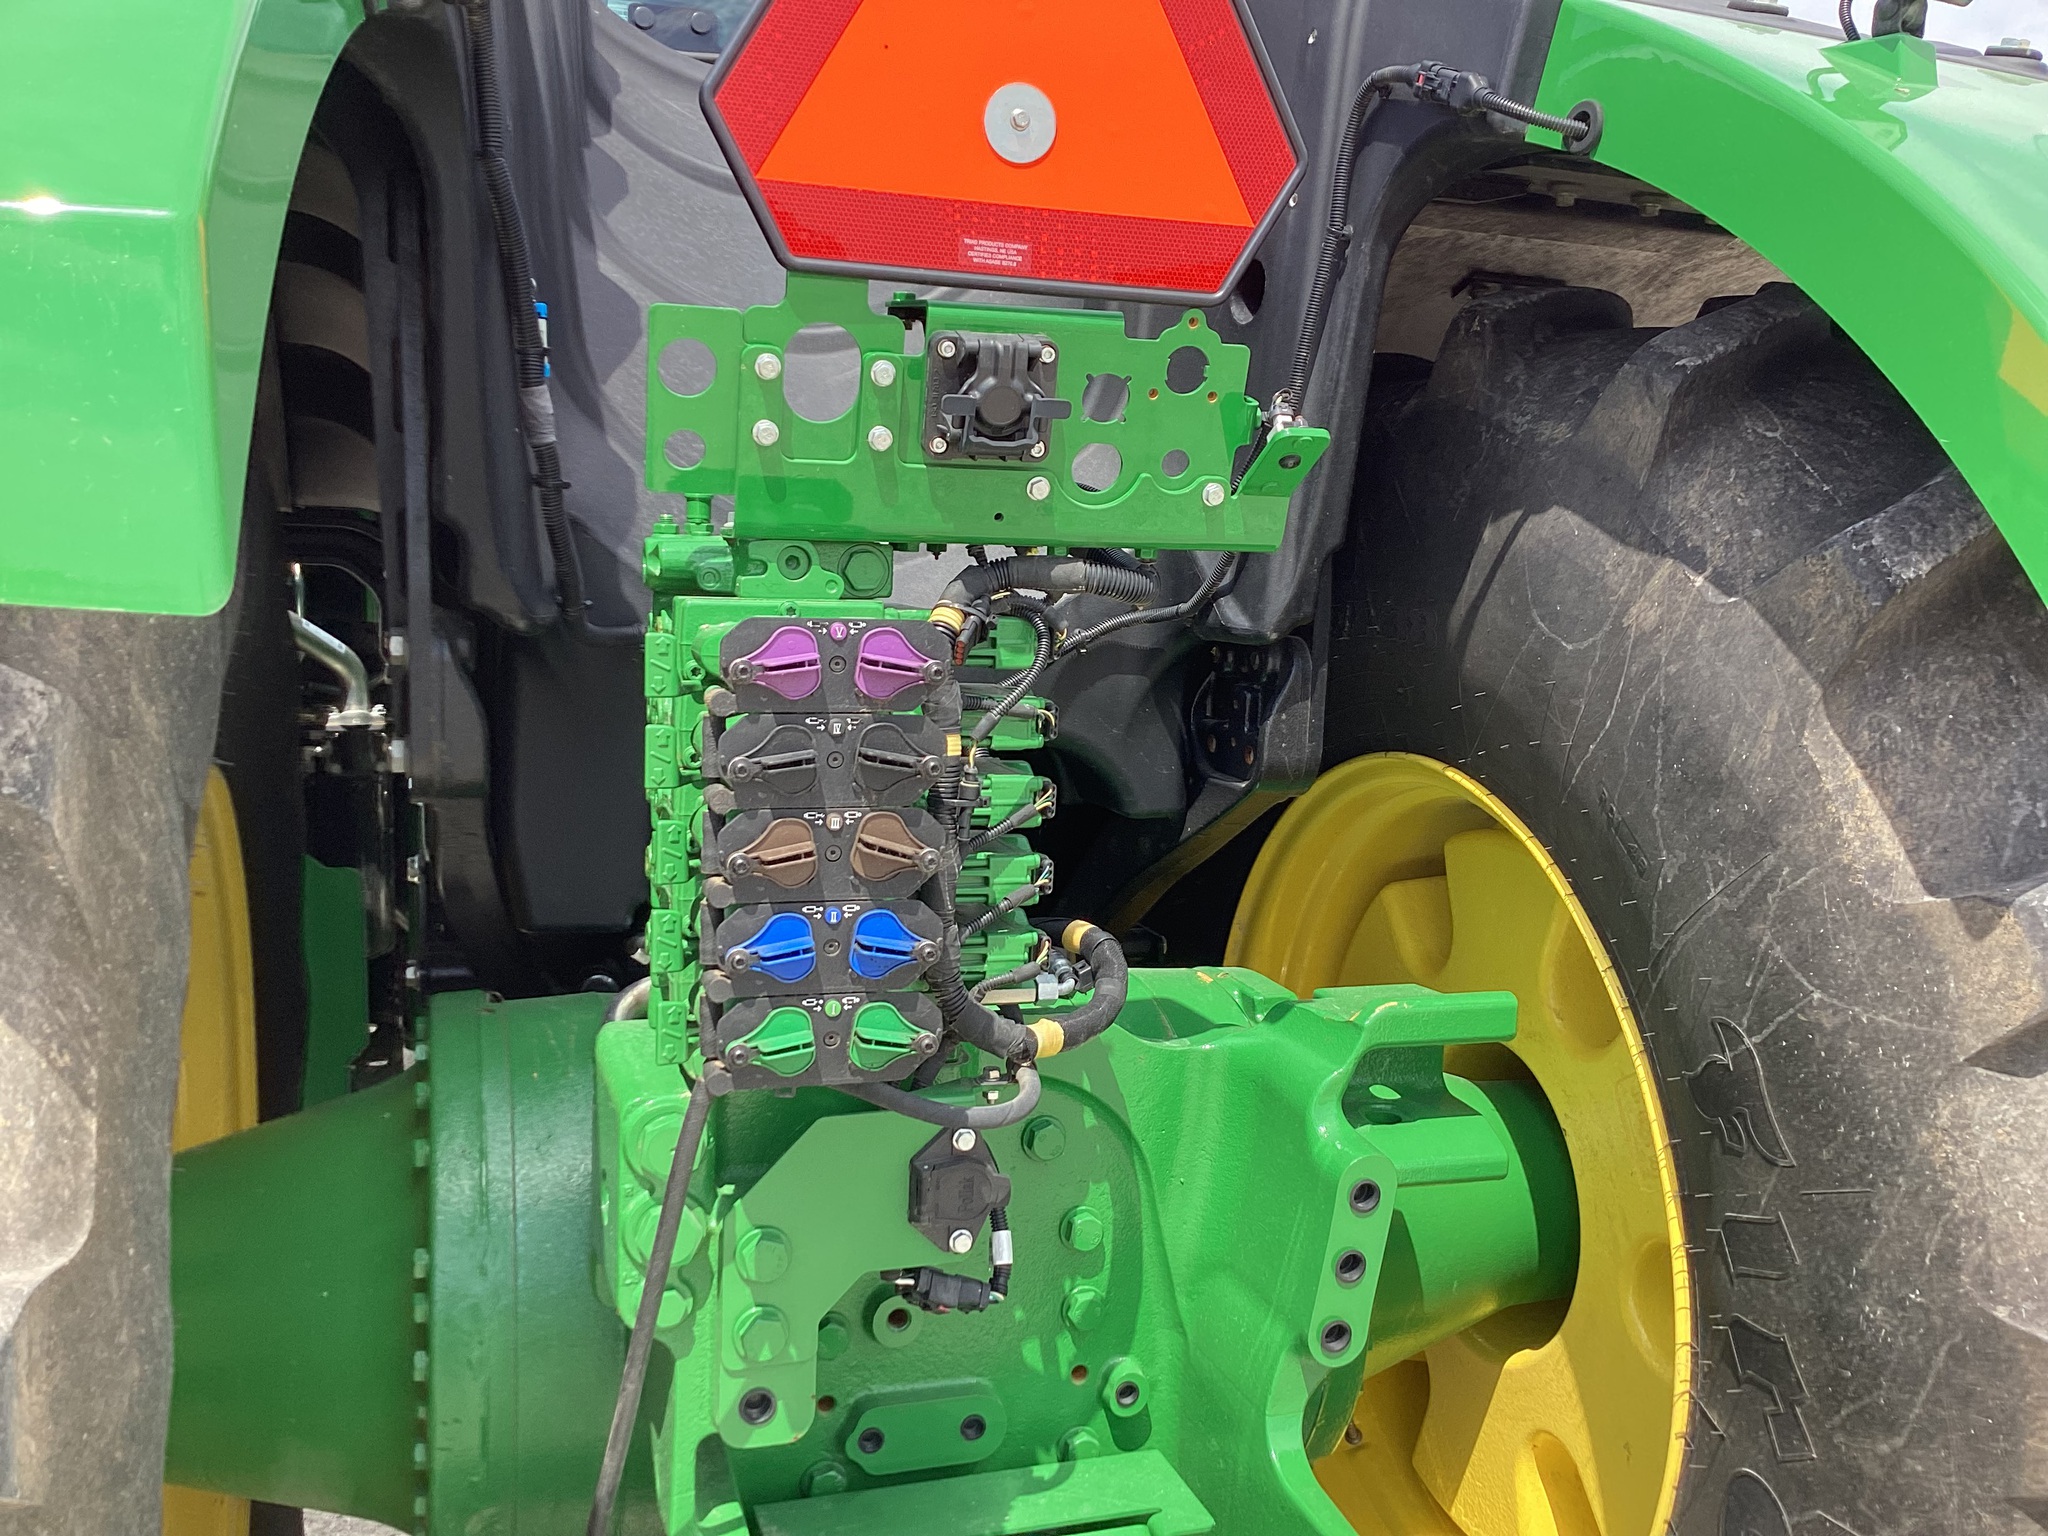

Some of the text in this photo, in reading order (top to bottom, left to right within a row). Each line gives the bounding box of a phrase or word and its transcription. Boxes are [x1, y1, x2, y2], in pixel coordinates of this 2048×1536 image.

[979, 240, 1004, 248] PRODUCTS
[836, 627, 844, 638] V
[830, 817, 841, 829] III
[830, 911, 838, 923] II
